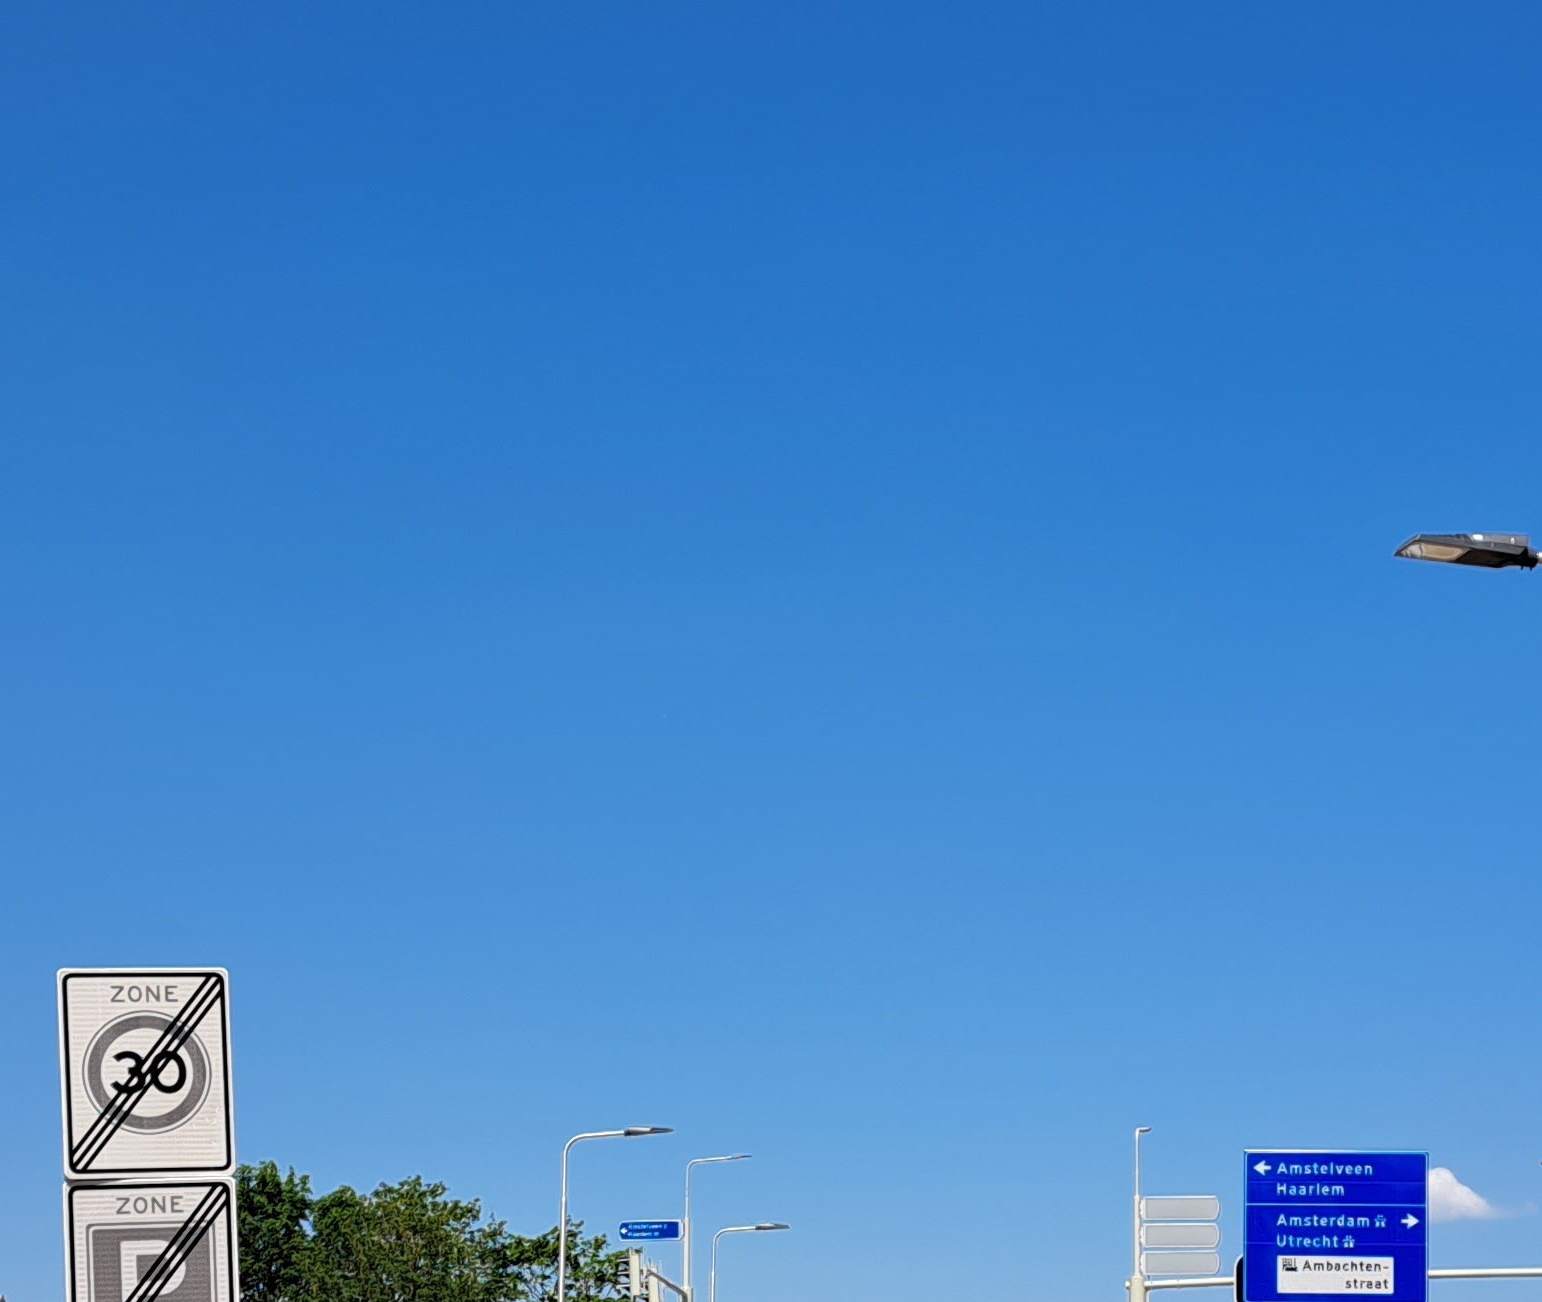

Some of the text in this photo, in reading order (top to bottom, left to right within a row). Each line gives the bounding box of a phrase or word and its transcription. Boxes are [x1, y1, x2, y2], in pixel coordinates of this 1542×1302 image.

[110, 985, 179, 1003] ZONE
[111, 1049, 187, 1095] 30
[1277, 1161, 1373, 1176] Amstelveen
[1276, 1183, 1345, 1196] Haarlem
[115, 1196, 185, 1215] ZONE
[1276, 1213, 1370, 1227] Amsterdam
[1276, 1234, 1339, 1248] Utrecht
[1302, 1260, 1389, 1272] Ambachten-
[1345, 1278, 1389, 1290] straat
